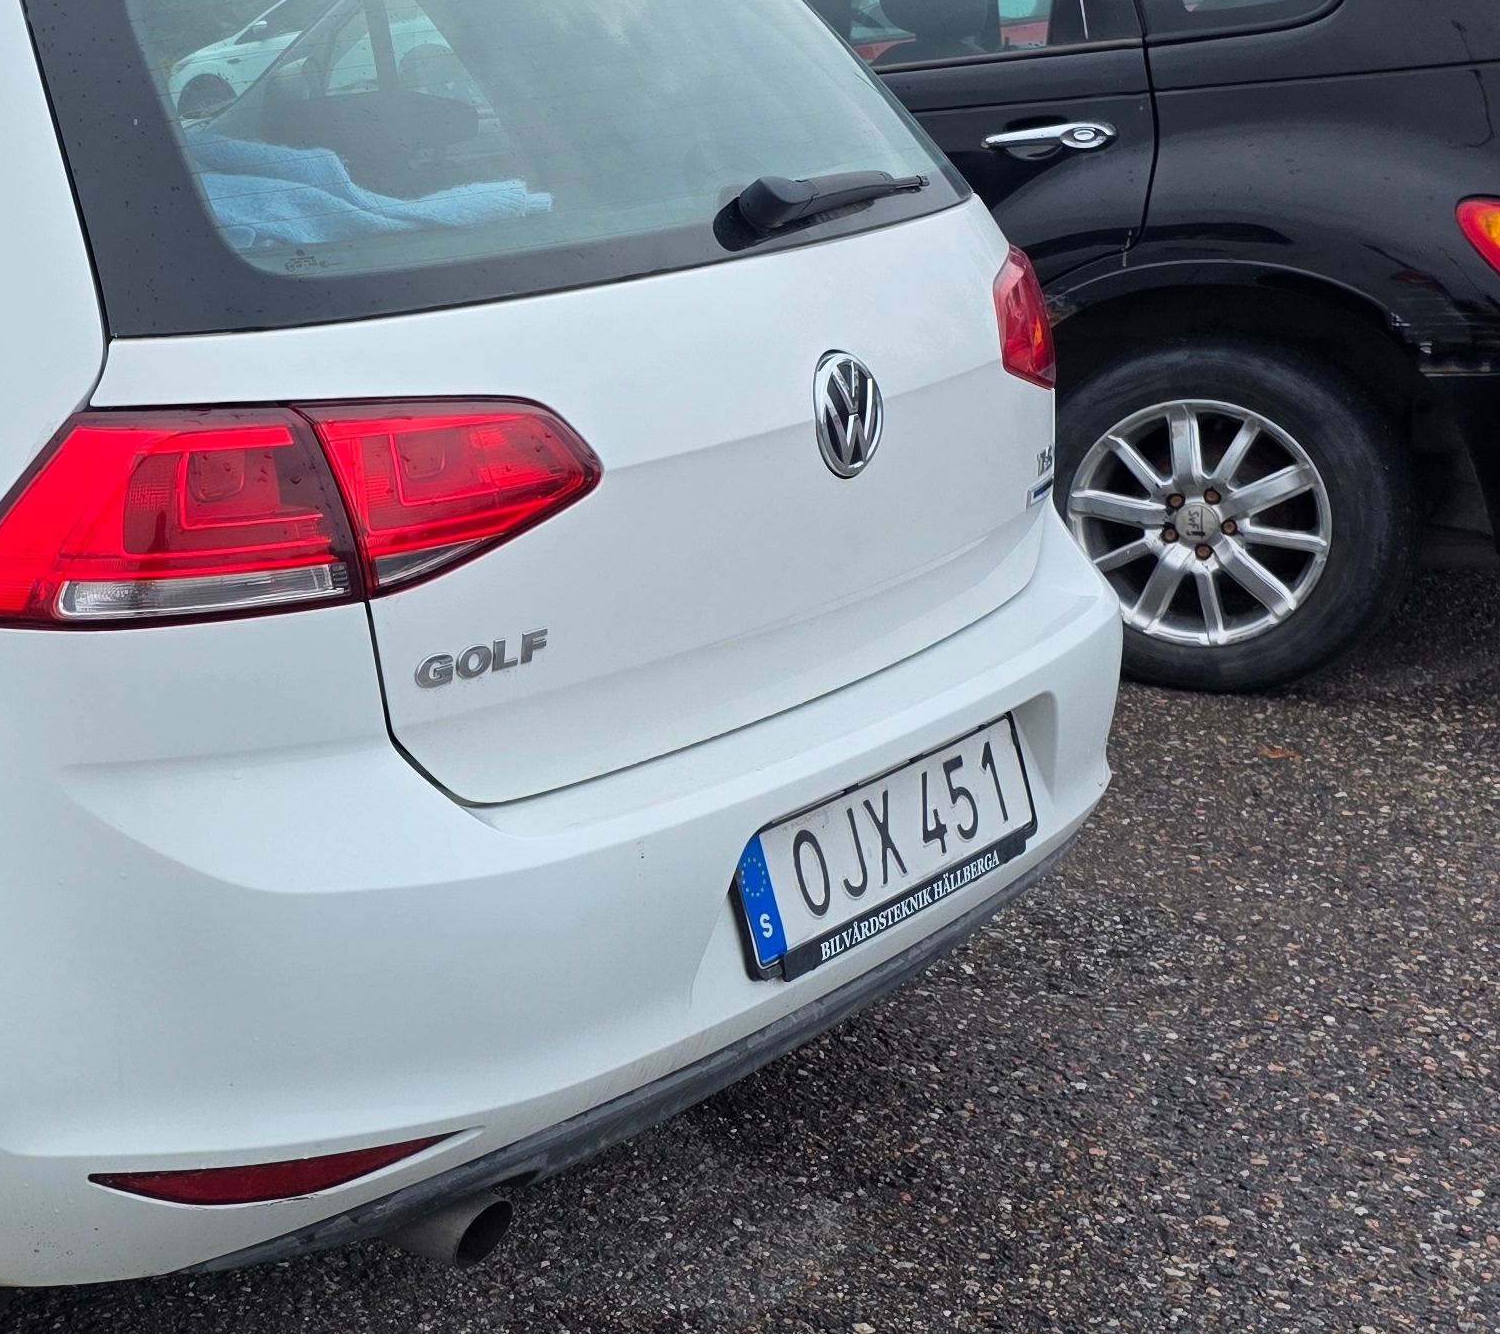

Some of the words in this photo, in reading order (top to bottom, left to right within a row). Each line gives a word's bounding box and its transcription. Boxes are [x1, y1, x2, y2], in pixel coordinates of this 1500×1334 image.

[414, 626, 548, 689] GOLF
[760, 913, 773, 938] S
[793, 789, 907, 917] OJX
[922, 741, 1009, 855] 451
[820, 886, 934, 961] BILVÅRDSTEKNIK
[933, 849, 1001, 900] HÄLLBERGA
